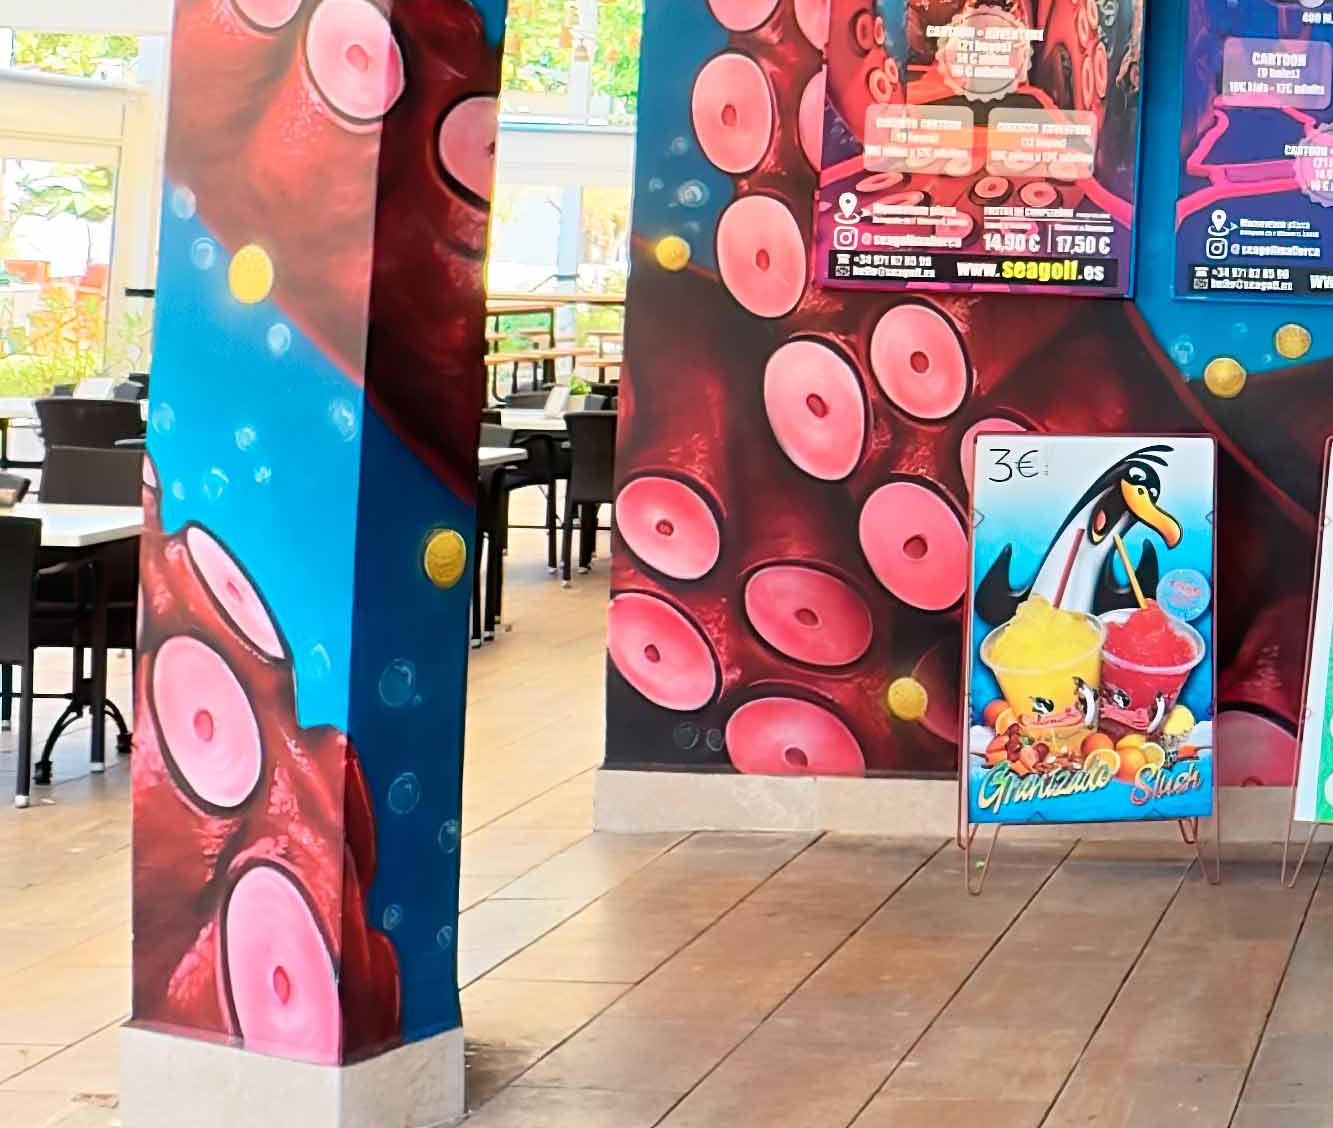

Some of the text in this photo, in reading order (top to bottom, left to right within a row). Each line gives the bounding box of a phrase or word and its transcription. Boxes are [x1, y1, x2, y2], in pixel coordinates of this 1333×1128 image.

[1252, 52, 1307, 66] CARTOON
[983, 232, 1026, 252] 14,90
[1056, 235, 1111, 254] 17,50 €
[956, 259, 1105, 282] www.seagolf.es
[988, 448, 1039, 482] 3€
[978, 759, 1201, 814] Granizado Slush
